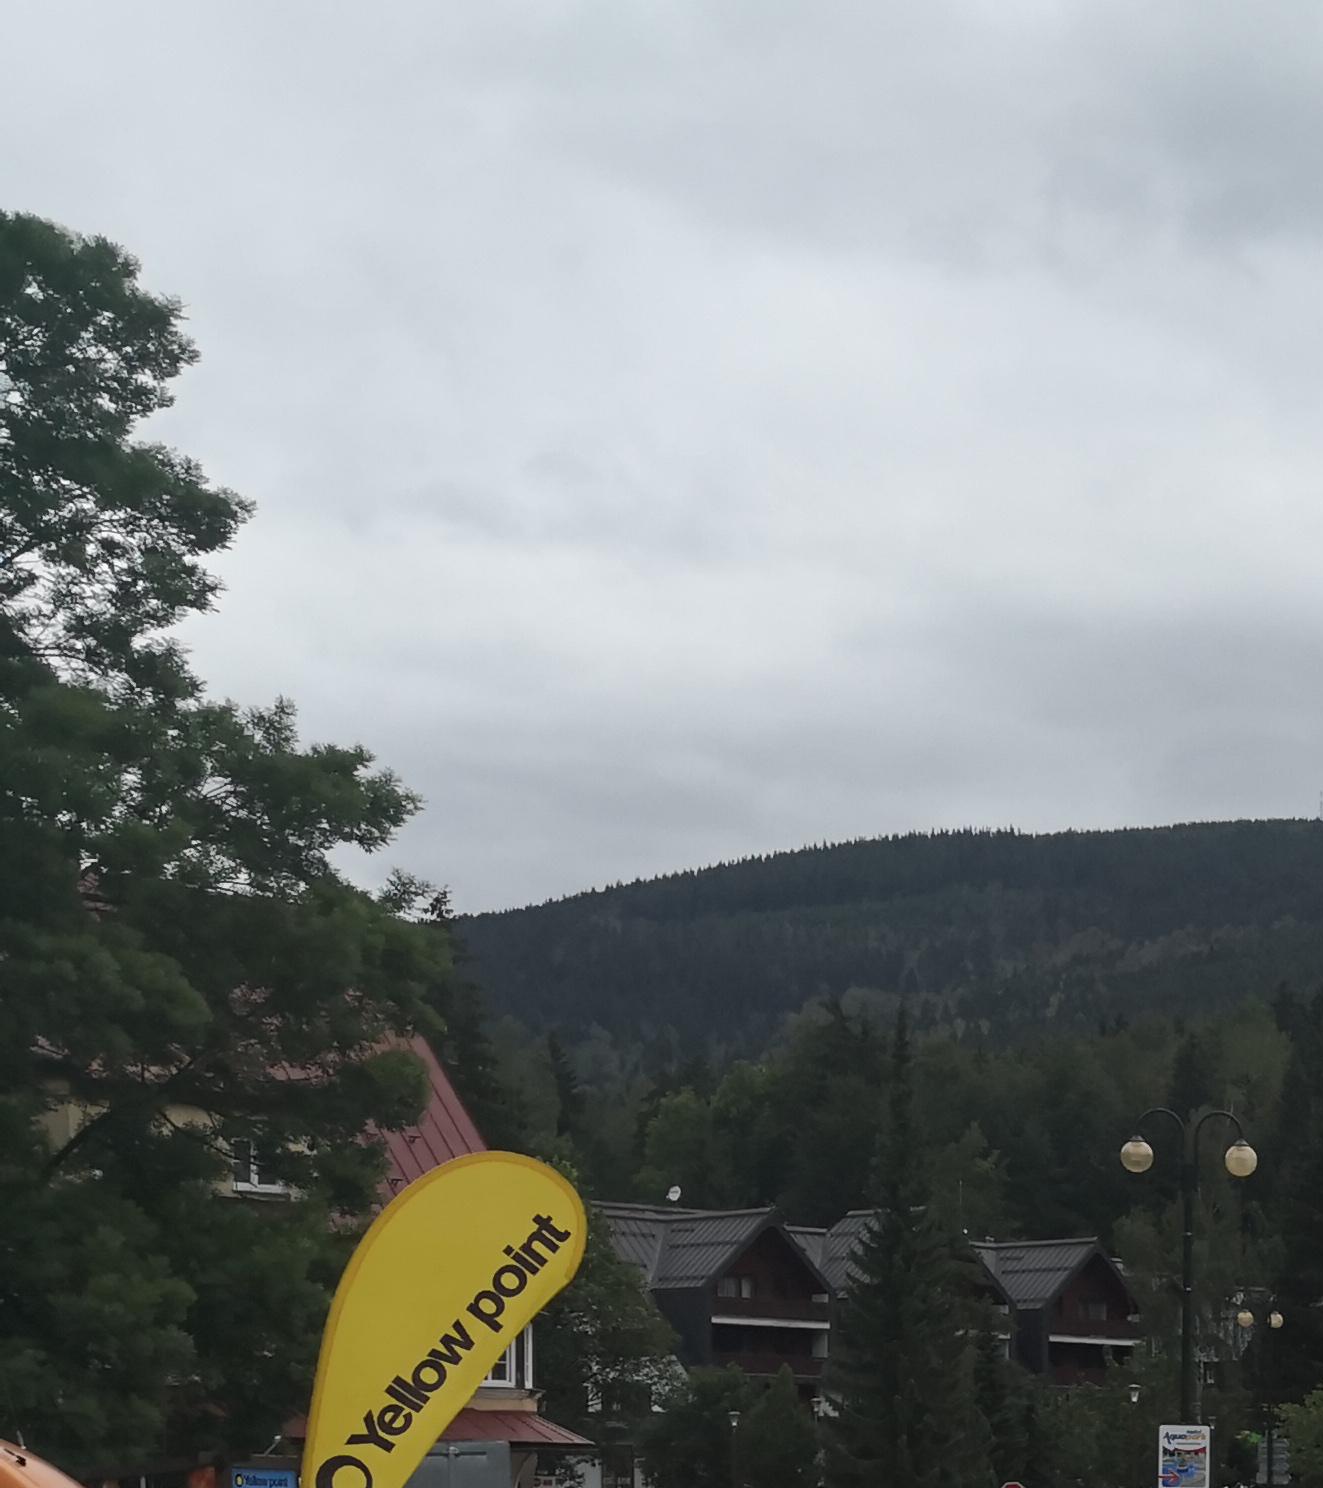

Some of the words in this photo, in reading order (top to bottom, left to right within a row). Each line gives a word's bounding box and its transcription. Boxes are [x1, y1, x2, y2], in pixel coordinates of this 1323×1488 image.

[347, 1318, 475, 1453] Yellow
[467, 1212, 571, 1333] point
[267, 1476, 288, 1488] point
